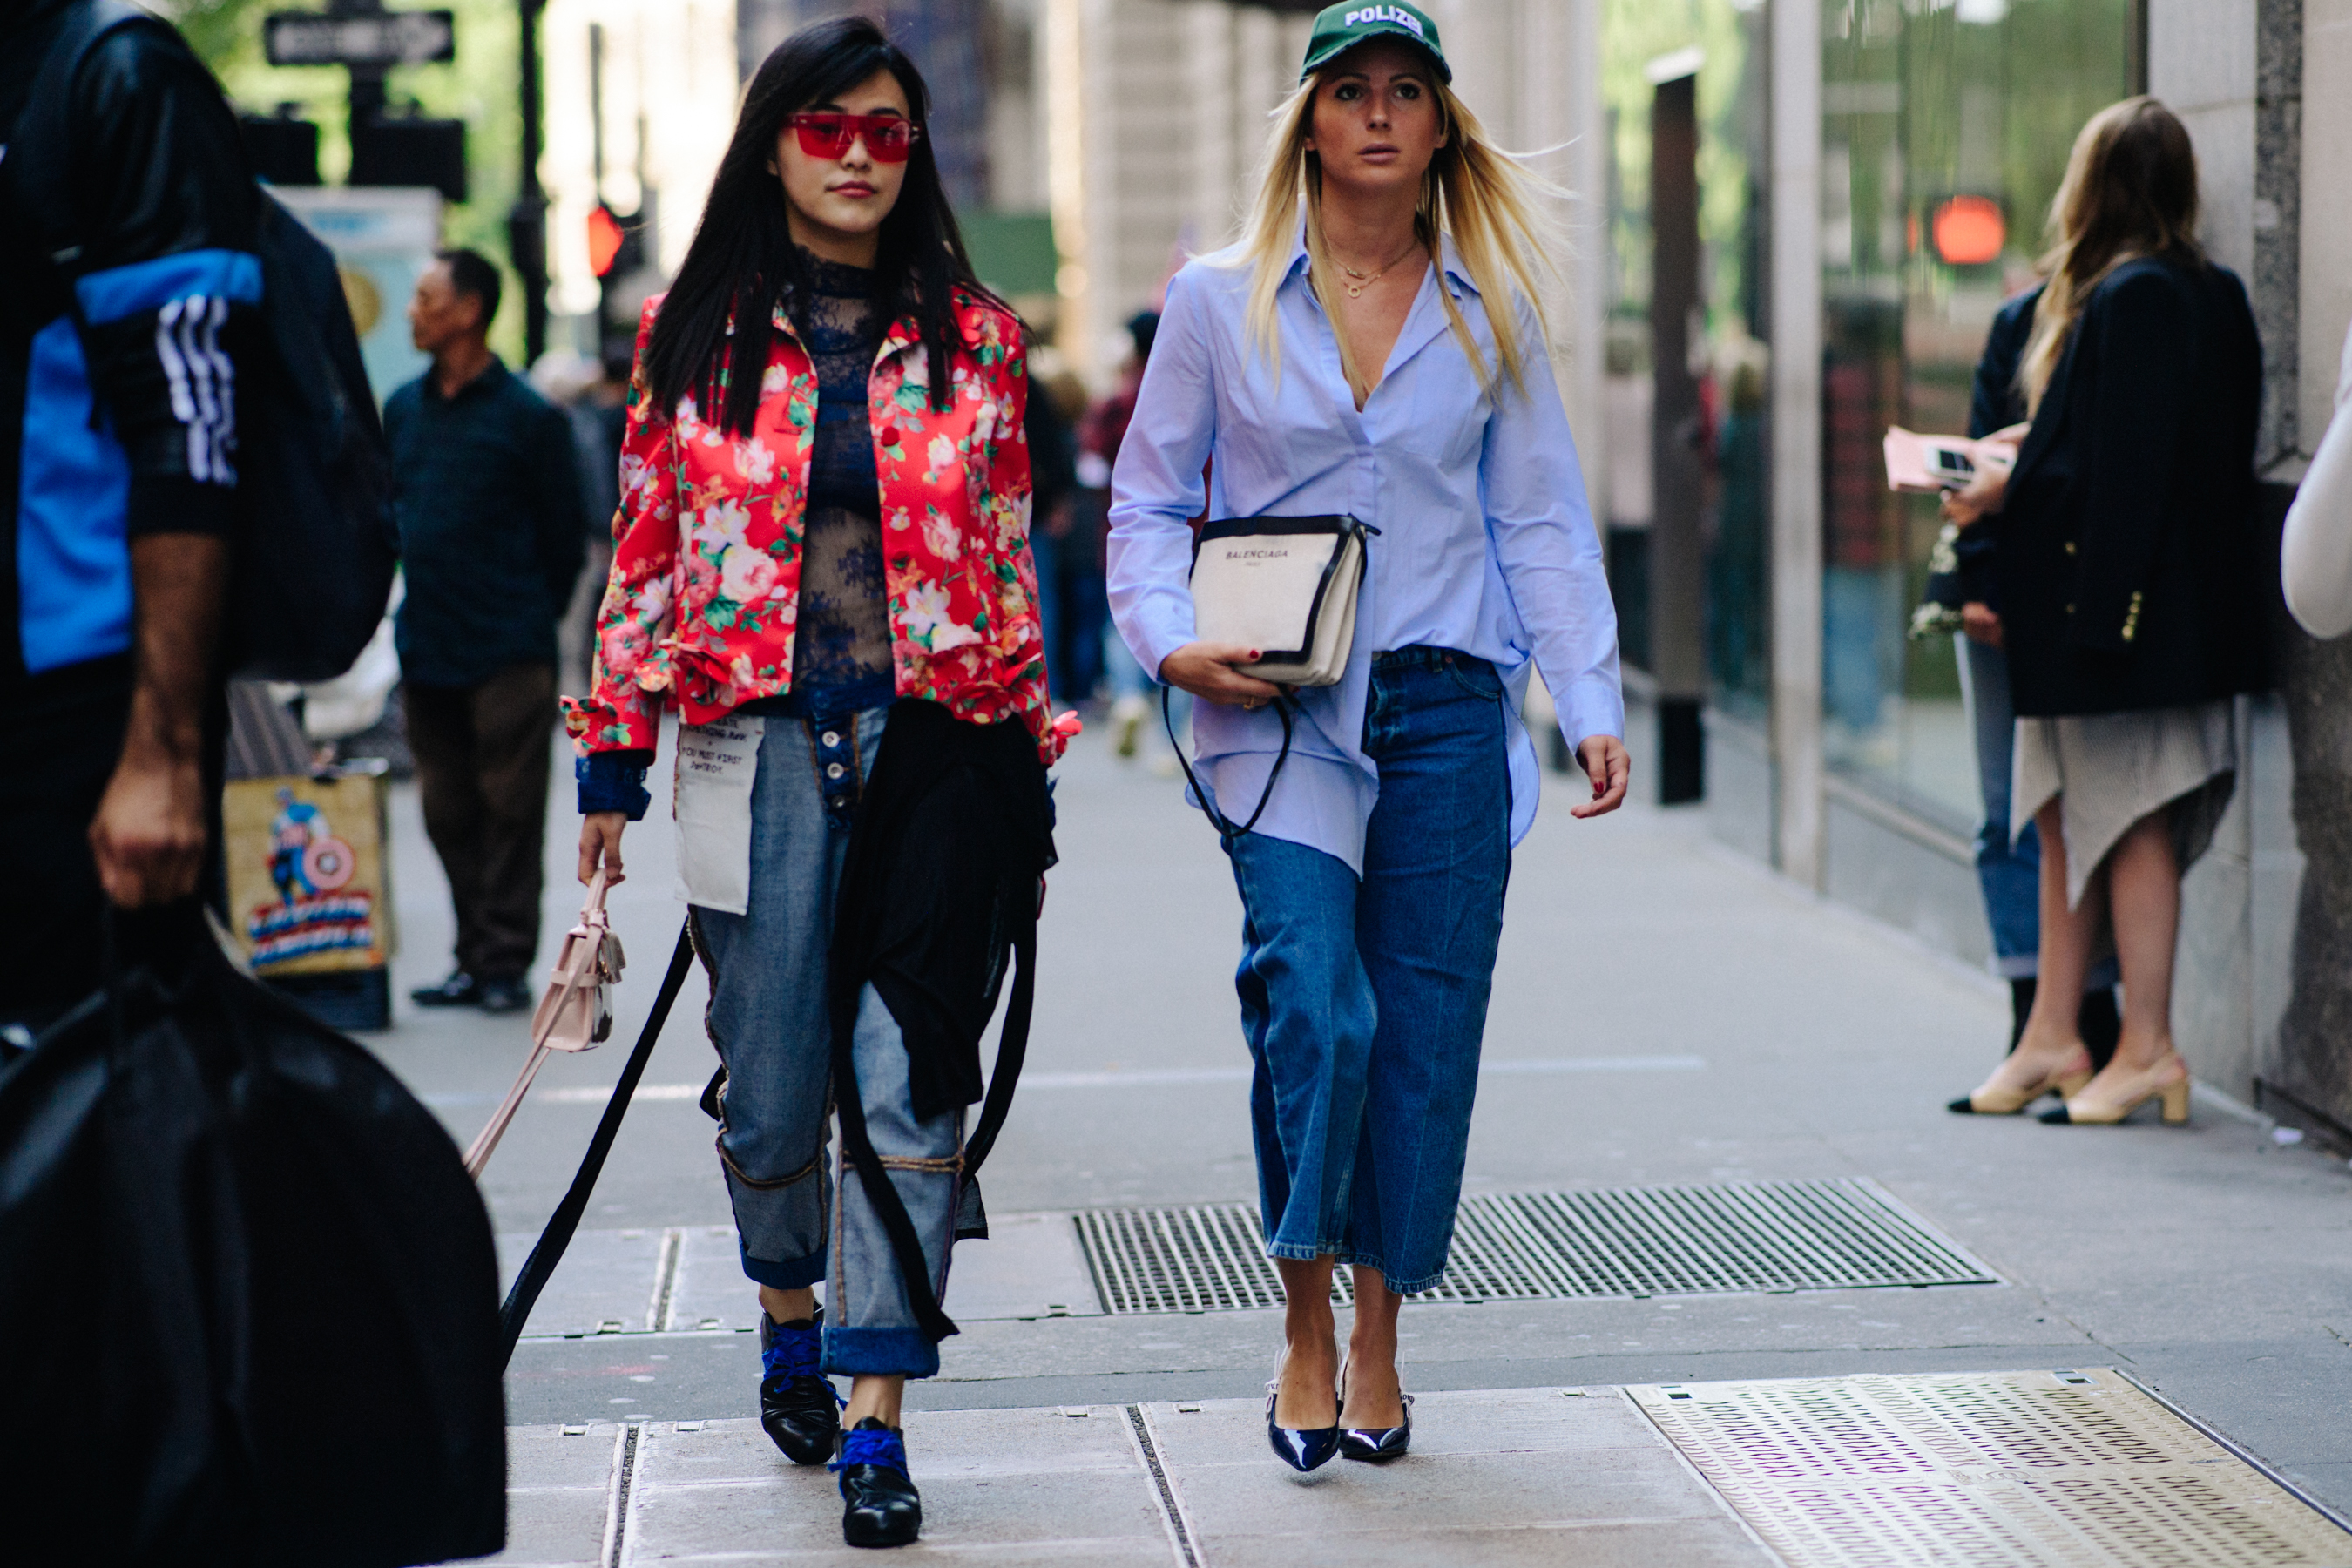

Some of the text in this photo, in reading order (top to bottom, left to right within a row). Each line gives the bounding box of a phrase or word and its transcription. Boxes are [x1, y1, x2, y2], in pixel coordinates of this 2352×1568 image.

[1345, 5, 1424, 37] POLIZEI
[1225, 550, 1288, 559] BALENCIAGA
[717, 754, 742, 765] FIRST
